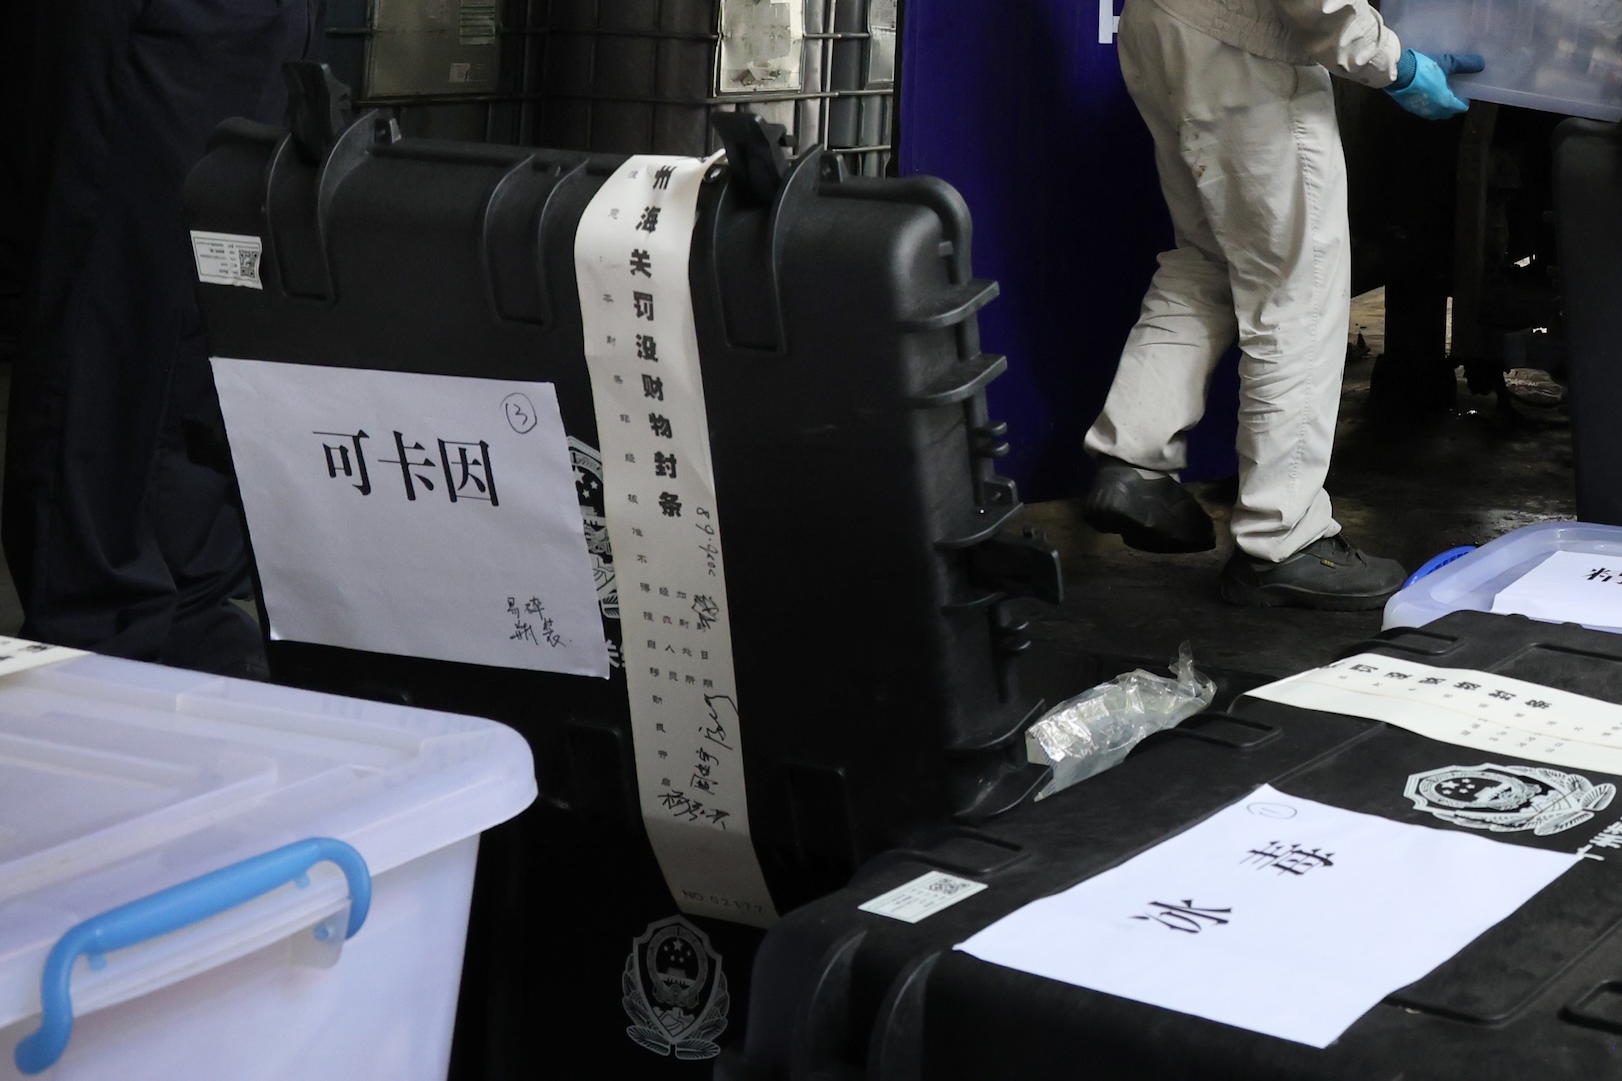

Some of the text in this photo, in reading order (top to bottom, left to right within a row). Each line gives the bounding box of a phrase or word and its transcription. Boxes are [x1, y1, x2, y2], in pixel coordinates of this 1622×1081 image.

[630, 164, 683, 518] 州海关罚没财物封条
[311, 428, 500, 507] 可卡因
